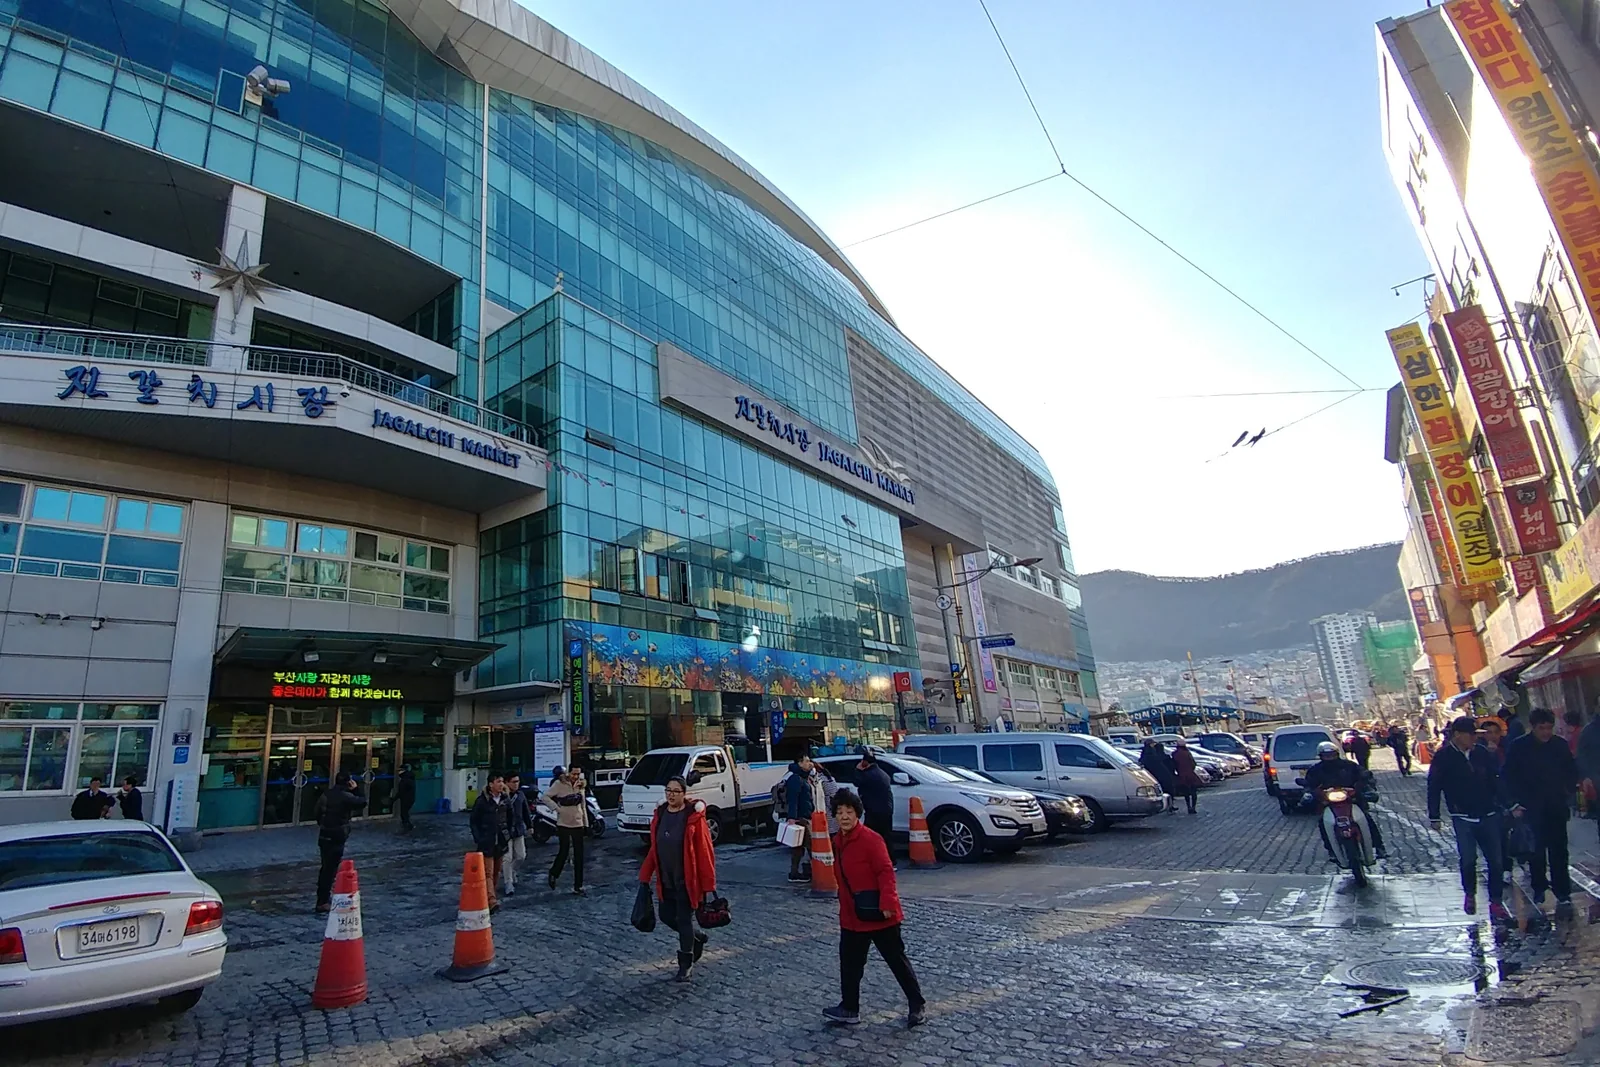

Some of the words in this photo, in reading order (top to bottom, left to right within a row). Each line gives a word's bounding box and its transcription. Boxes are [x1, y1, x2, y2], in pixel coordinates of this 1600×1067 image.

[1507, 91, 1573, 166] 원조
[372, 409, 455, 448] JAGALCHI
[461, 437, 521, 469] MARKET
[818, 441, 873, 484] JAGALCHI
[876, 472, 916, 504] MARKET
[273, 672, 318, 684] 부산사랑
[320, 673, 371, 685] 자갈치사랑
[329, 687, 350, 699] 함께
[352, 688, 404, 699] 하겠습니다.
[573, 658, 582, 725] 에스컬레이터
